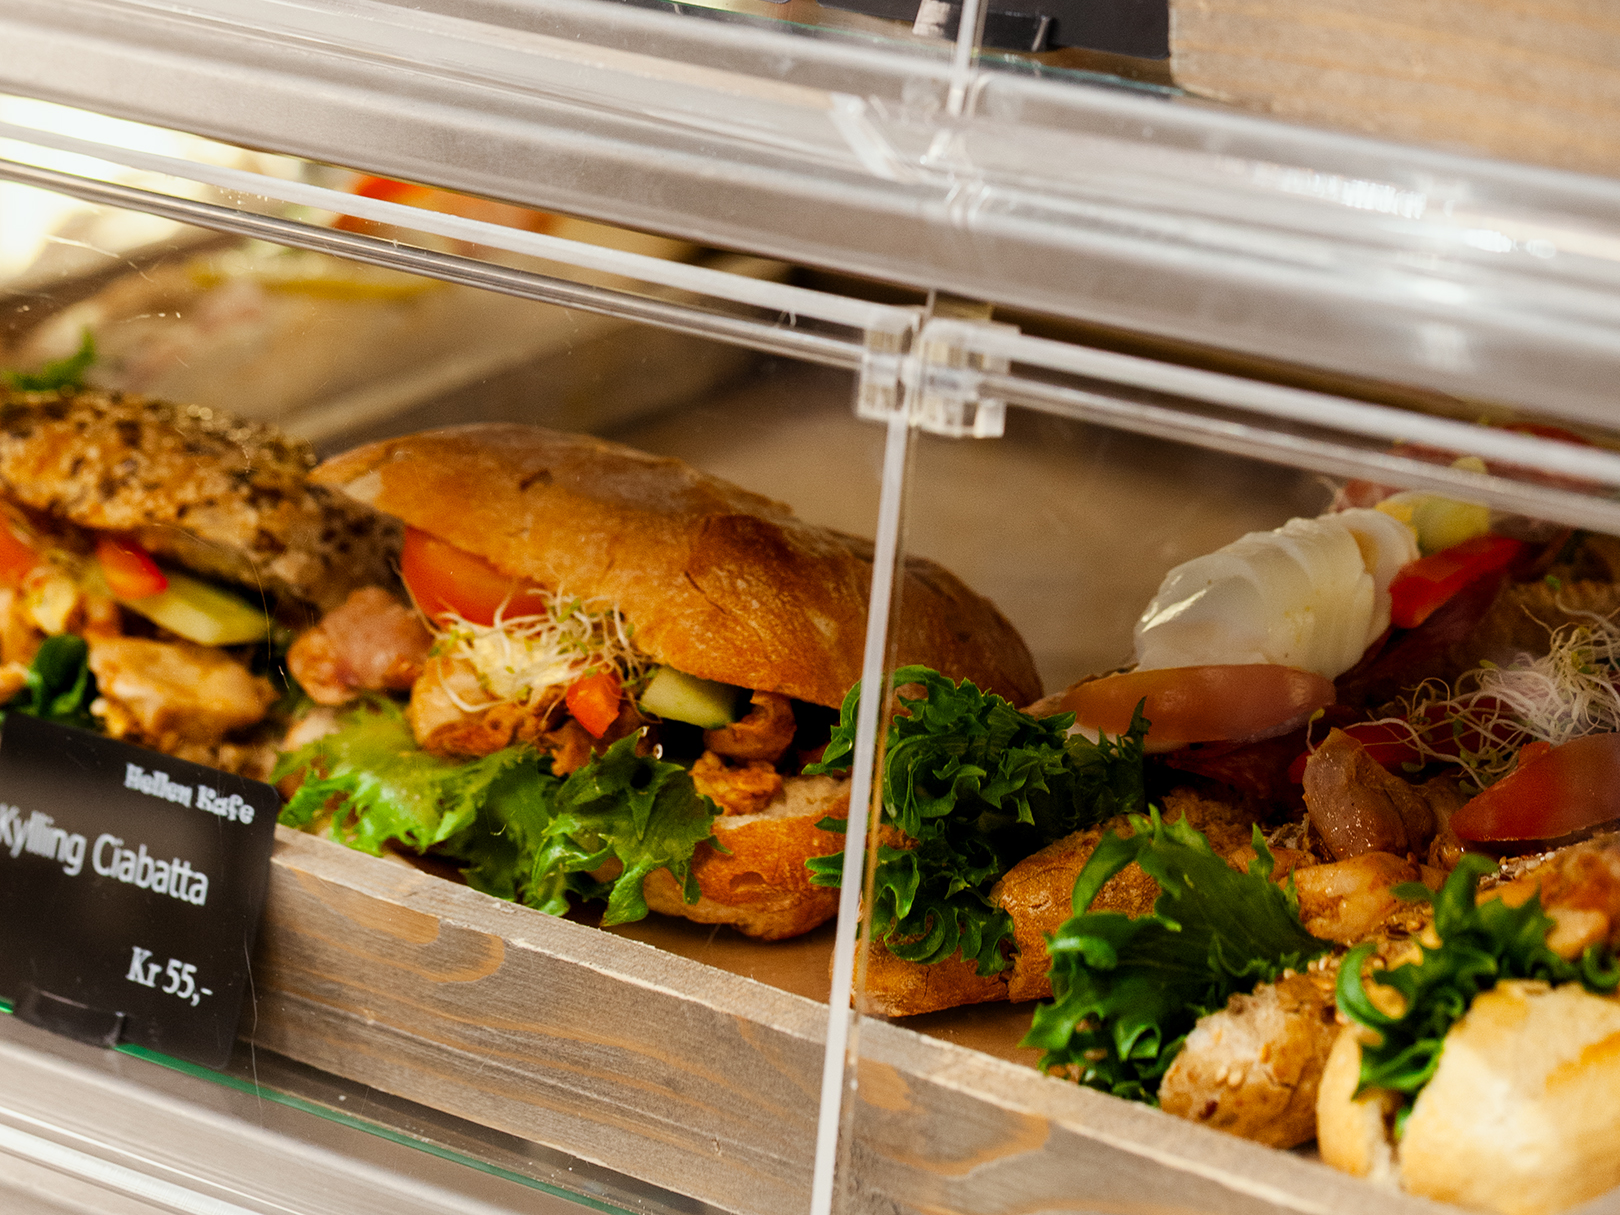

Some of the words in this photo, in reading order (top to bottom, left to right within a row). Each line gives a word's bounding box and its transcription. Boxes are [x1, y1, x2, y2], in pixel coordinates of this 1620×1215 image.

[124, 762, 193, 808] Hellen
[196, 785, 255, 824] Kafe
[92, 833, 209, 906] Ciabatta
[125, 946, 162, 987] Kr
[162, 958, 213, 1006] 55,-
